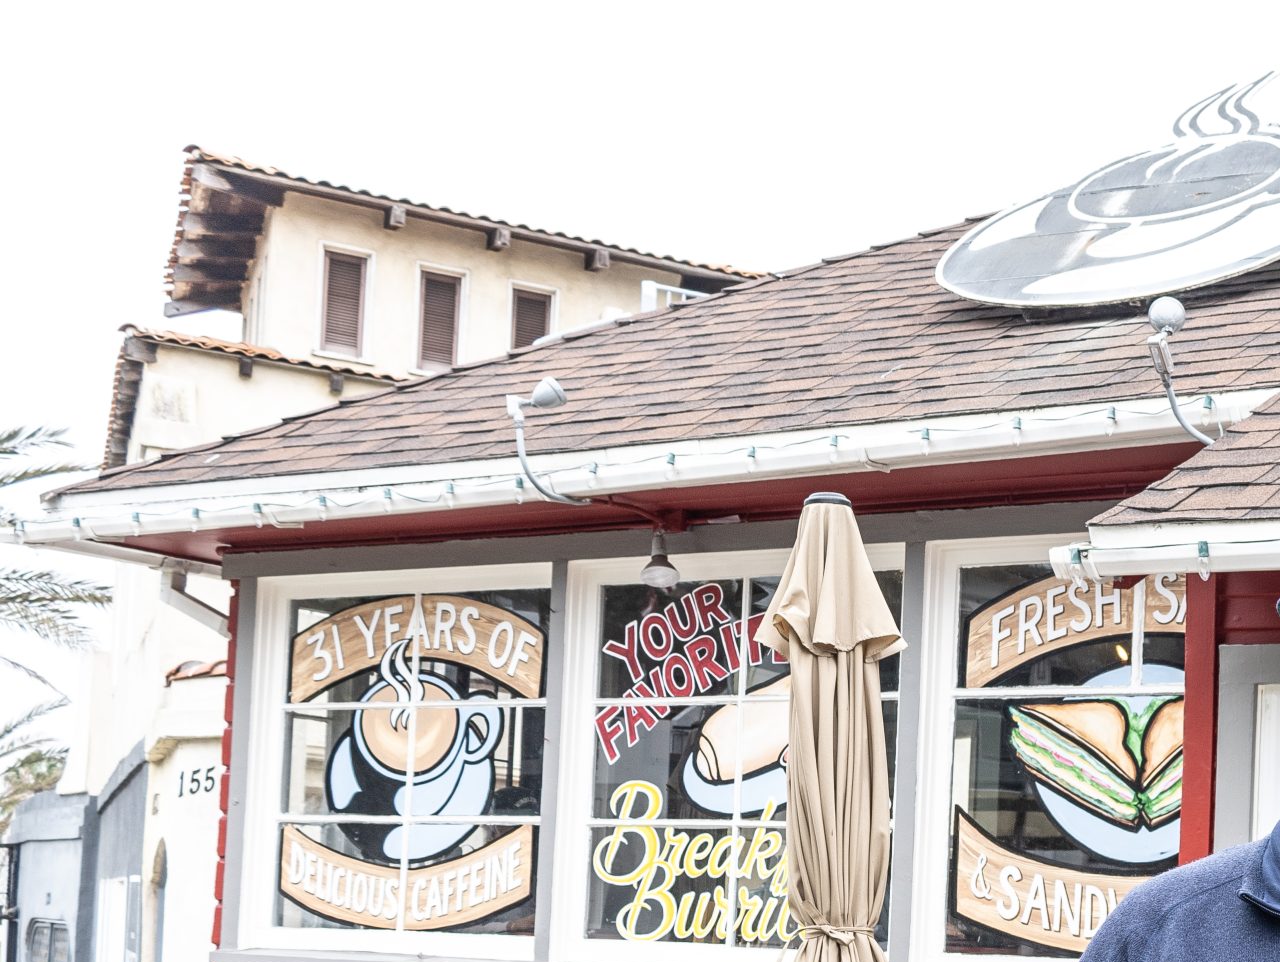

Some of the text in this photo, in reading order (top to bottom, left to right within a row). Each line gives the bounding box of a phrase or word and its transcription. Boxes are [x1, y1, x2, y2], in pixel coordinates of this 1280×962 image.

[307, 601, 537, 681] 31 YEARS OF
[602, 582, 732, 684] YOUR
[990, 577, 1122, 669] FRESH
[595, 611, 790, 766] FAVORIT
[178, 766, 215, 798] 155
[287, 840, 522, 921] DELICIOUS CAFFEINE
[969, 852, 993, 901] &
